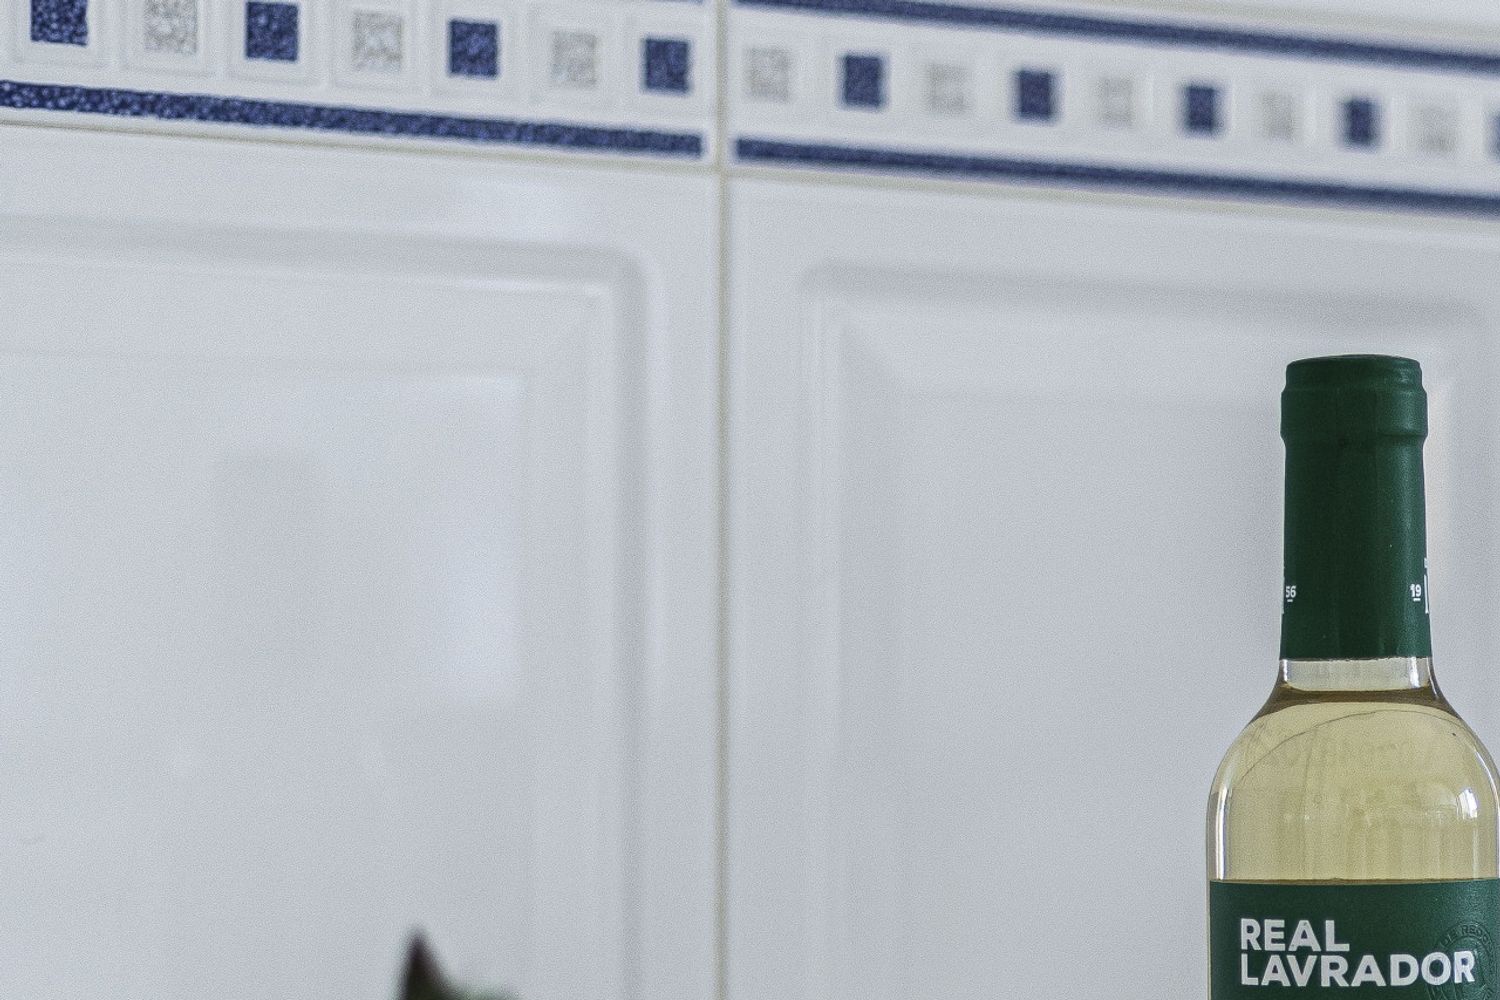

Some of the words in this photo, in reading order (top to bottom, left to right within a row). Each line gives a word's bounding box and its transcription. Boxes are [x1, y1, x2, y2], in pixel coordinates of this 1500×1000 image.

[1410, 583, 1421, 597] 19
[1240, 918, 1350, 952] REAL
[1240, 950, 1476, 987] LAVRADOR
